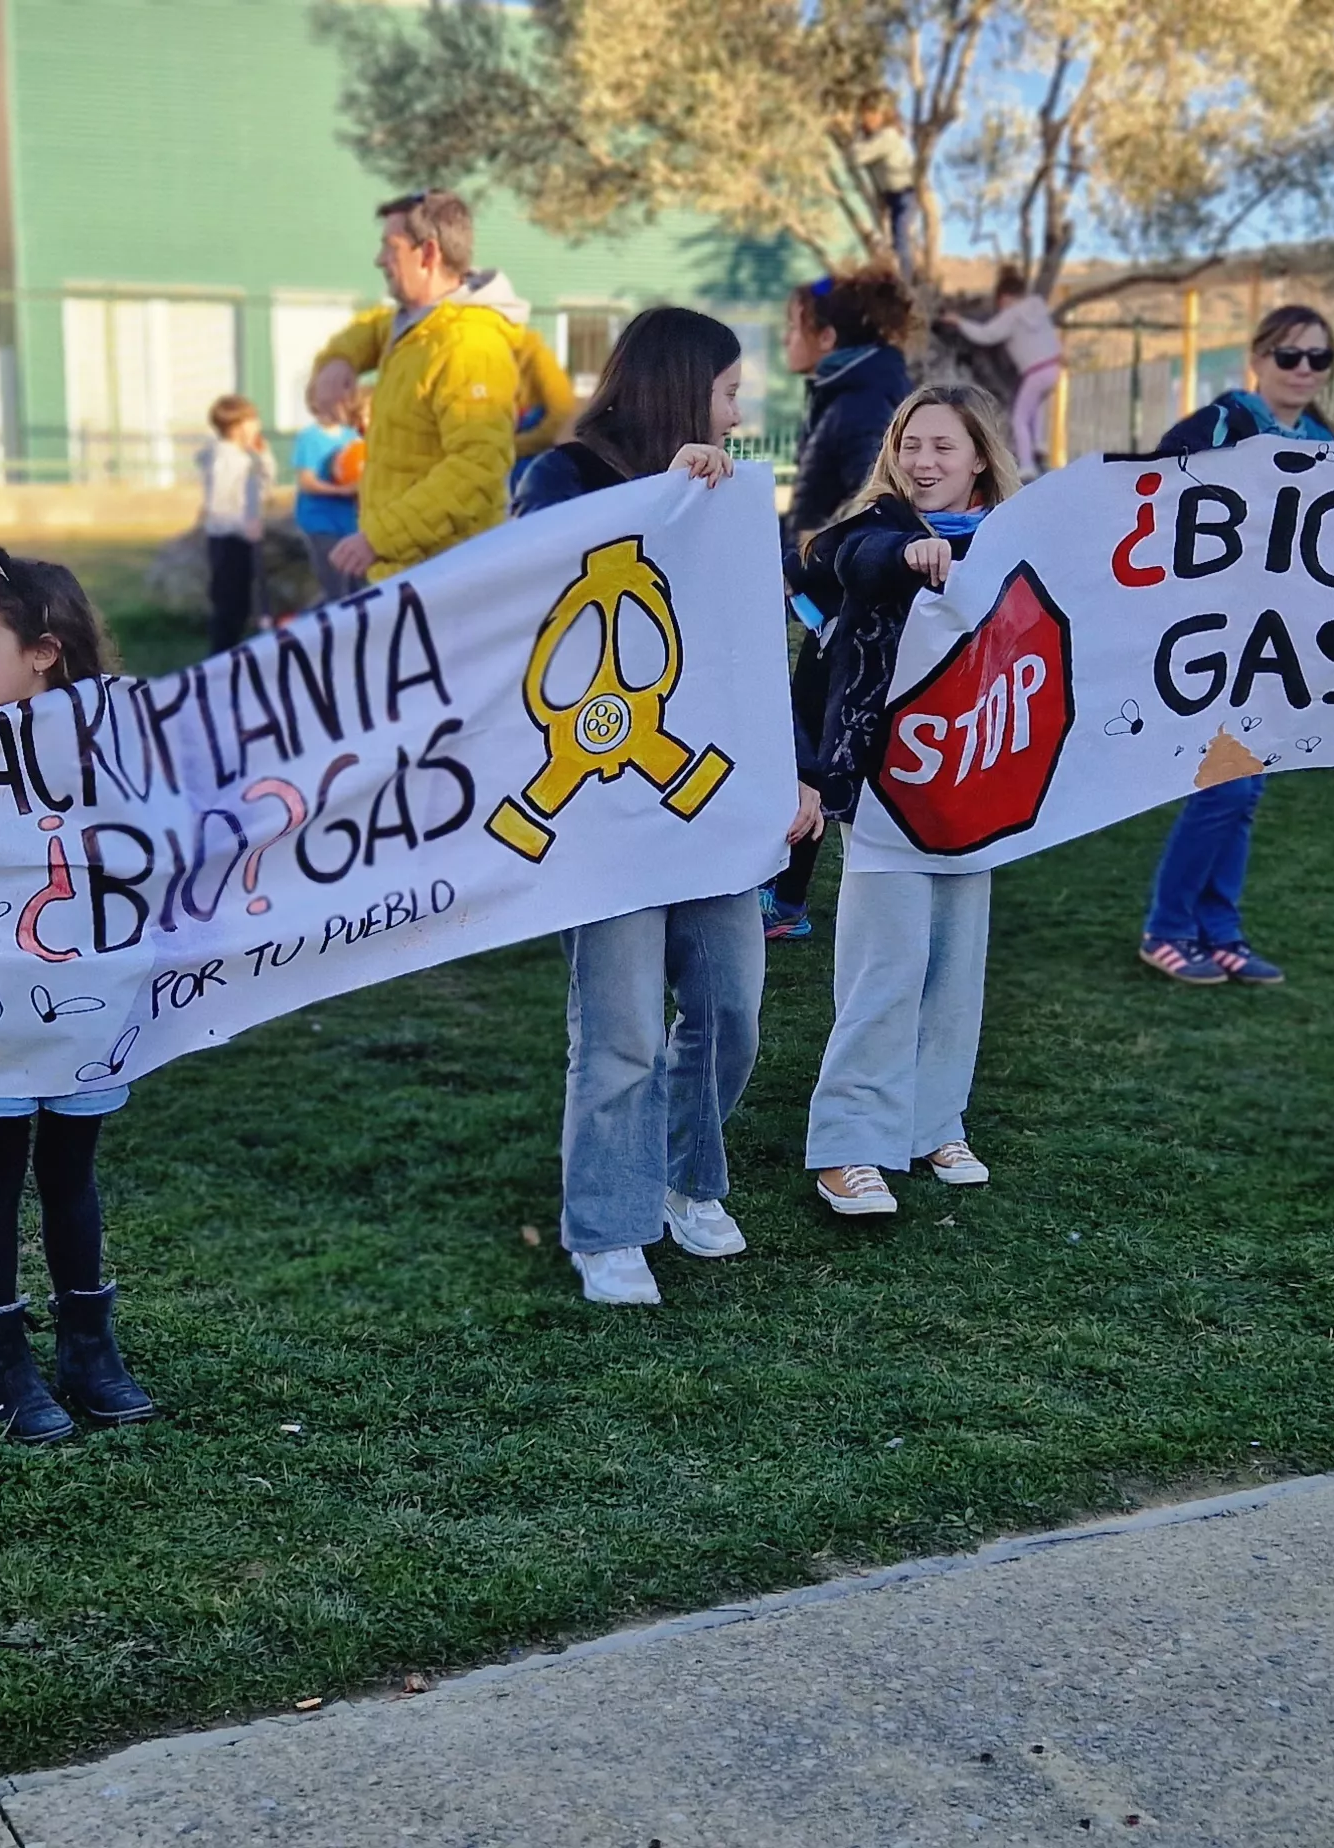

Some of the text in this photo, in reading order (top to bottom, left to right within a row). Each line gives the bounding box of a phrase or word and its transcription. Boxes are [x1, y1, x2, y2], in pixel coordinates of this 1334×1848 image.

[888, 652, 1048, 788] STOP
[151, 878, 457, 1020] POR TU PUEBLO
